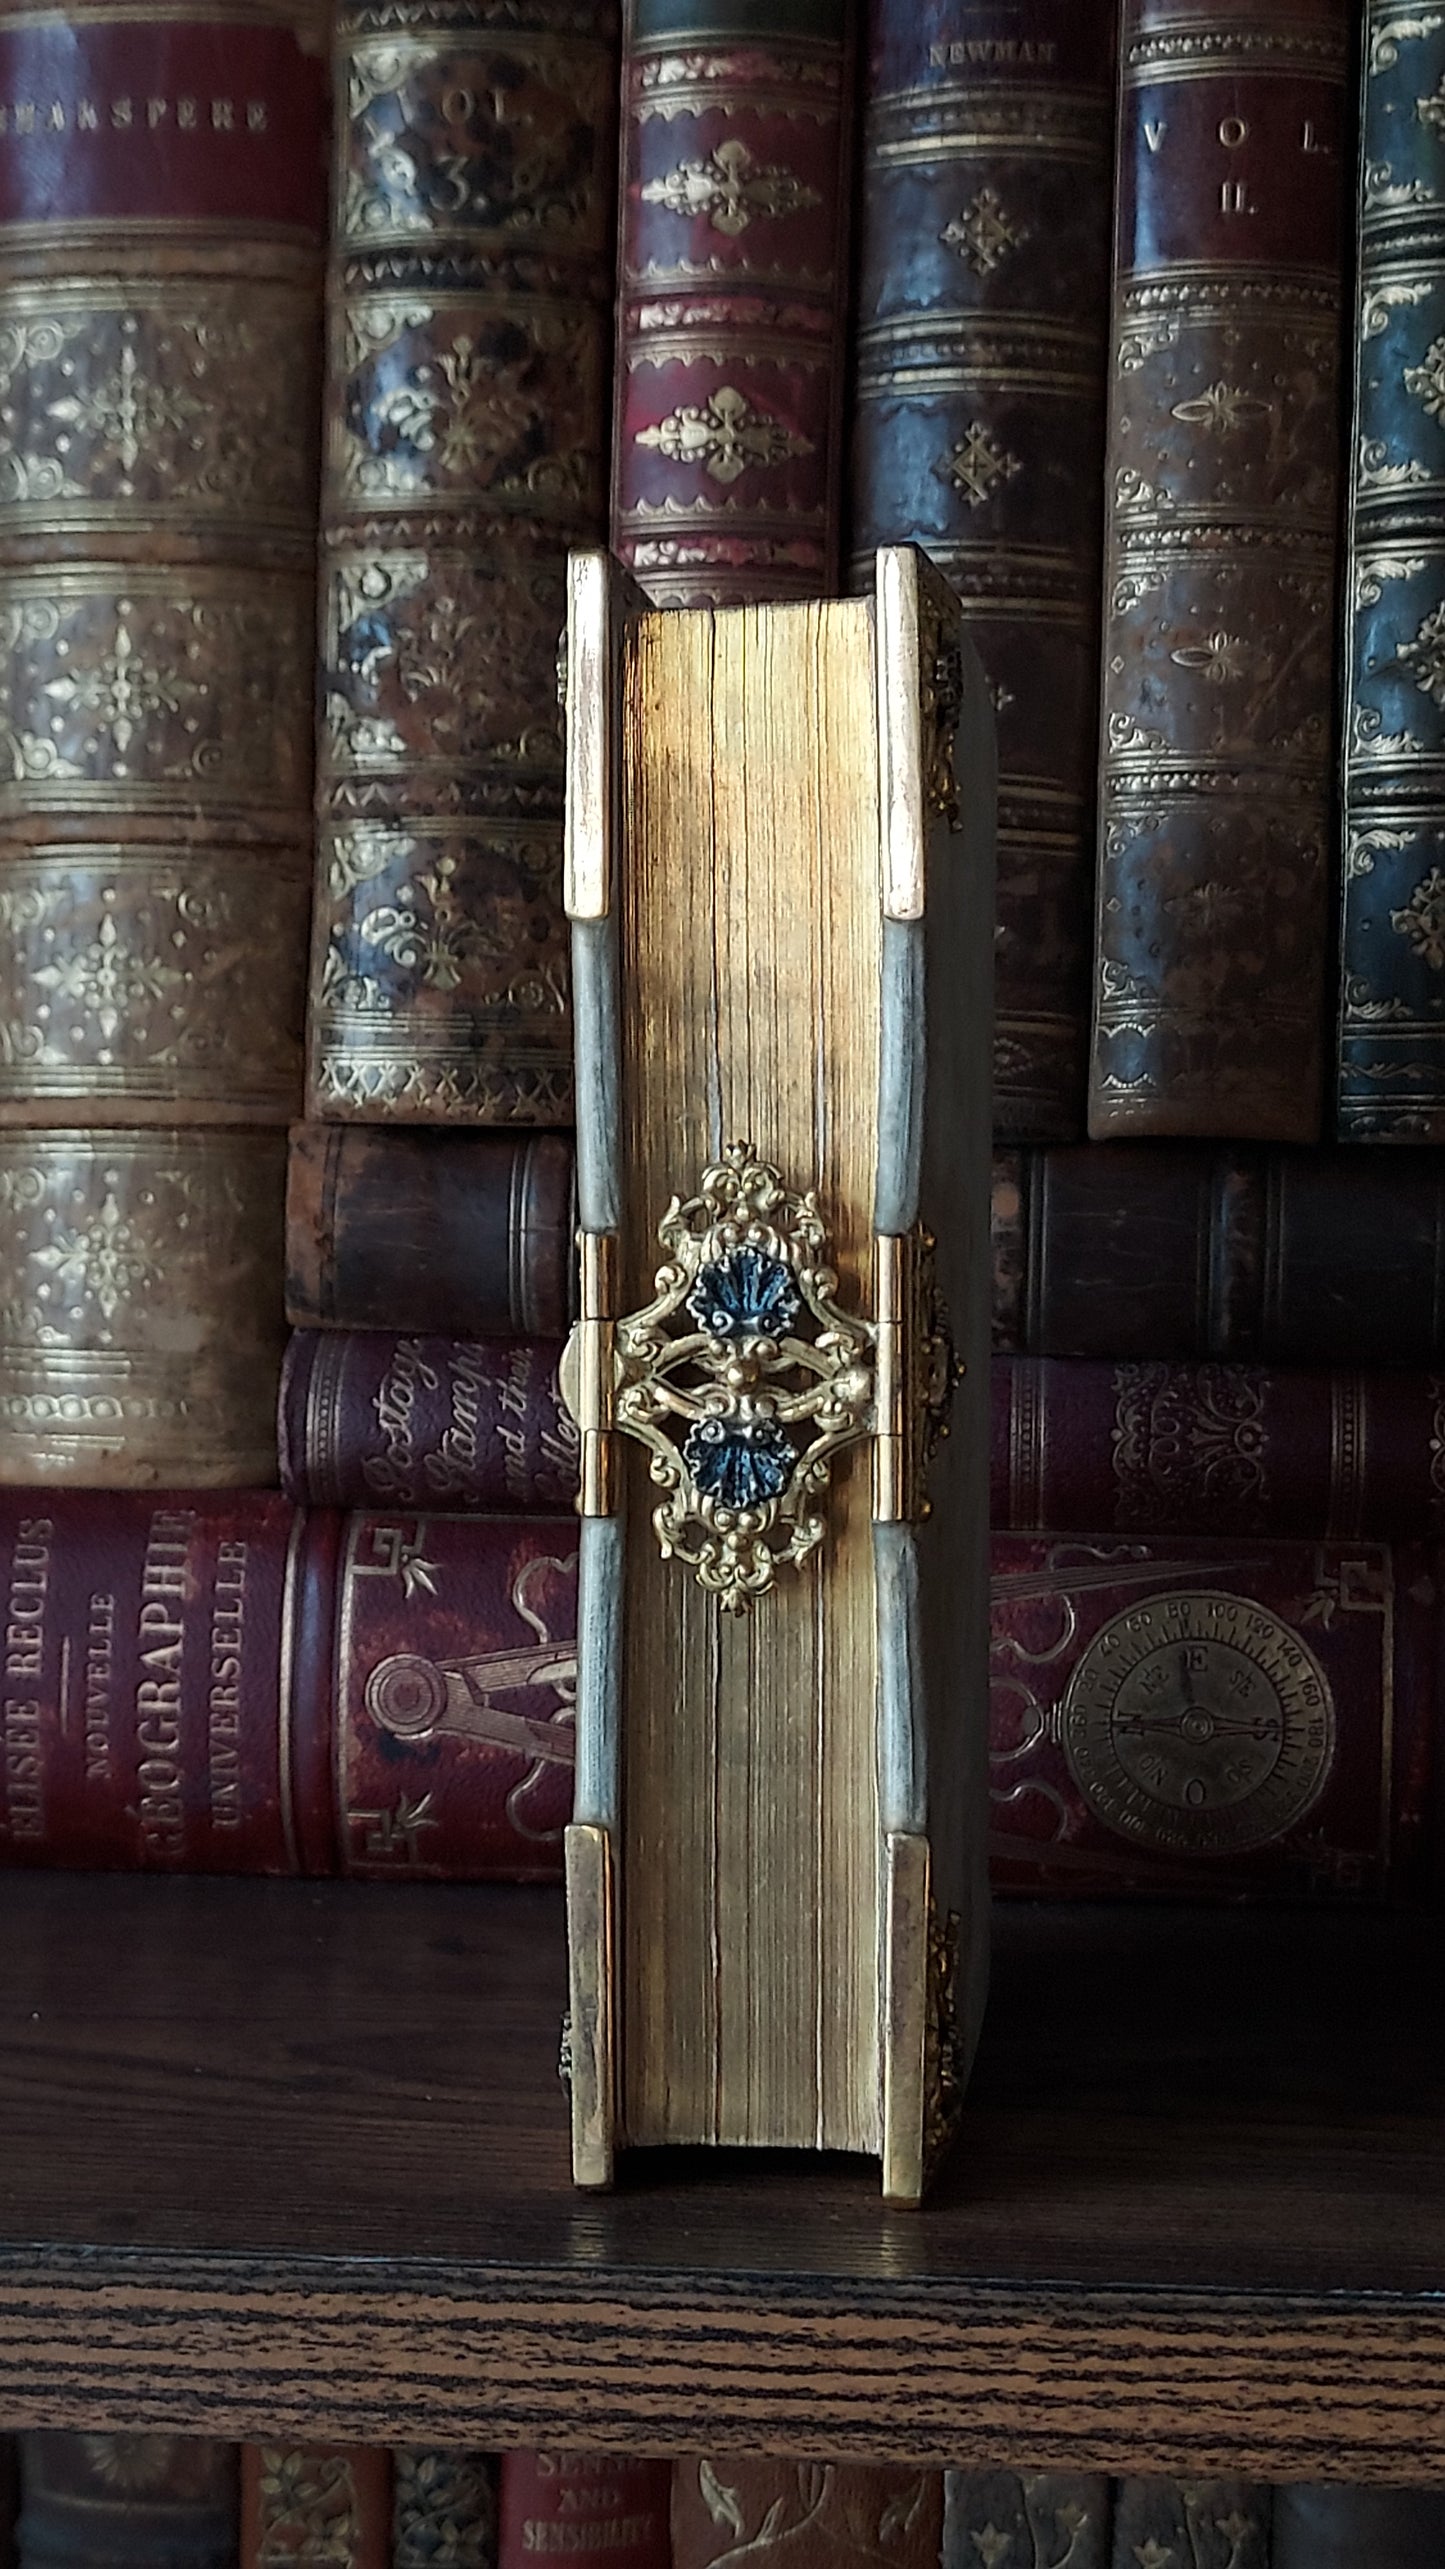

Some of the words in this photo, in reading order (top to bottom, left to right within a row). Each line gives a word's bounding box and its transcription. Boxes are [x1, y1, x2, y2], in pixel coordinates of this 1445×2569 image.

[929, 40, 1056, 68] NEWMAN
[5, 1515, 53, 1680] RECLUS
[1208, 1602, 1239, 1622] 100
[1277, 1638, 1303, 1668] 140
[84, 1593, 115, 1780] NOUVELLE
[207, 1540, 249, 1829] UNIVERSELLE
[1300, 1675, 1320, 1707] 160
[1307, 1716, 1324, 1749] 180
